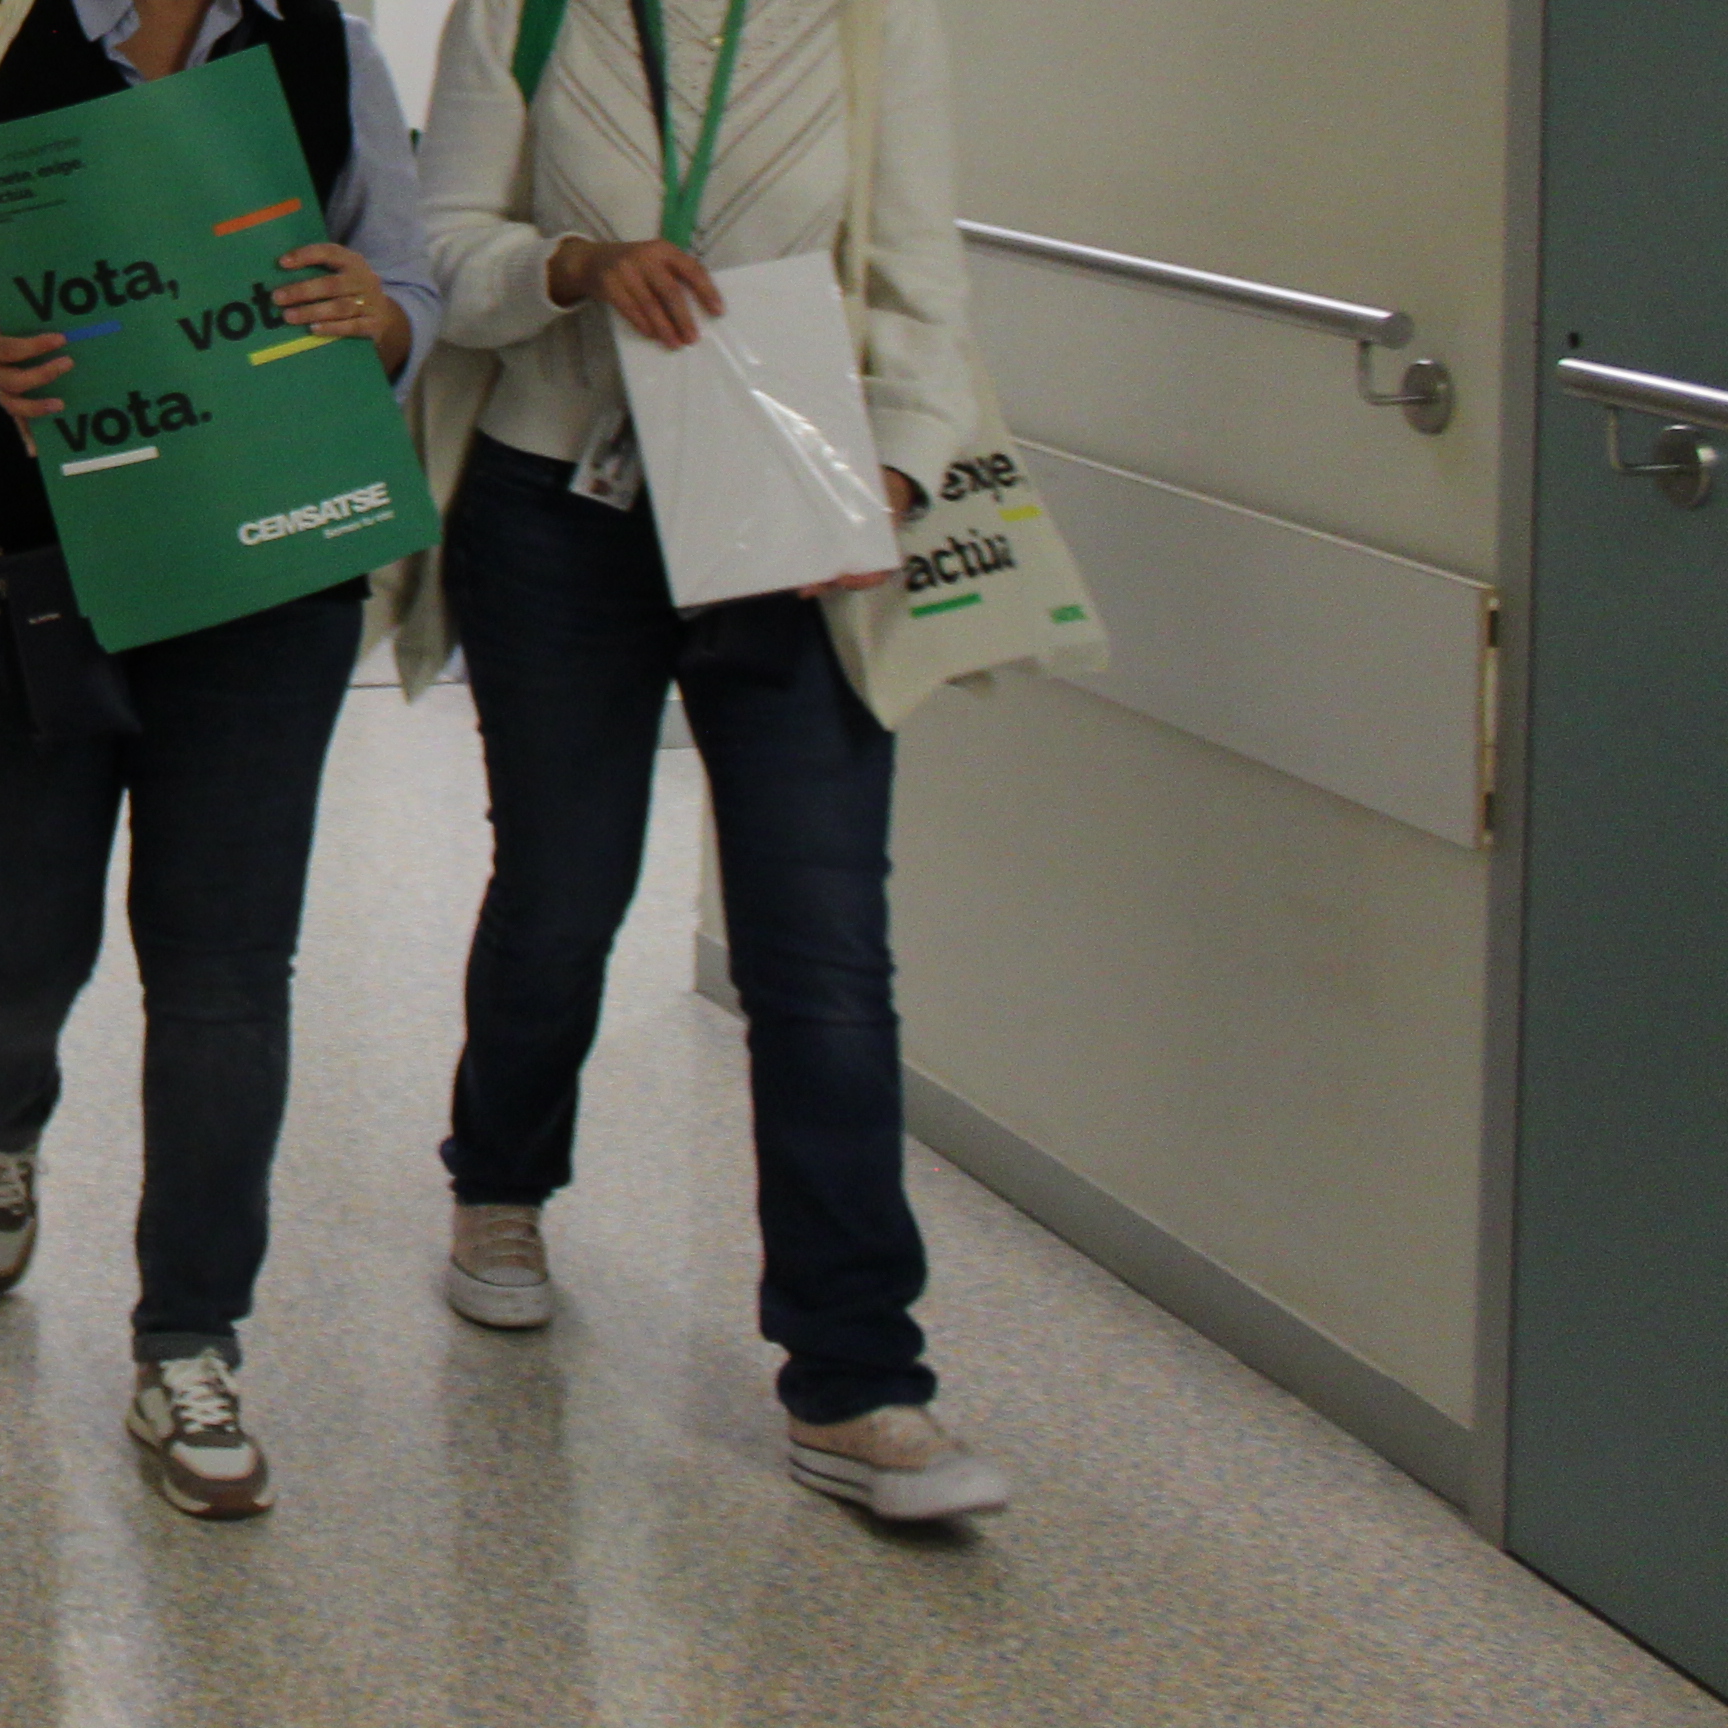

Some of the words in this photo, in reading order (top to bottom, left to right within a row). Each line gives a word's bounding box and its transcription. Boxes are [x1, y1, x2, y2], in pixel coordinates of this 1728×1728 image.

[13, 258, 180, 323] Vota,
[176, 282, 287, 351] vot
[53, 389, 213, 453] vota.
[237, 481, 392, 546] CEMSATSE
